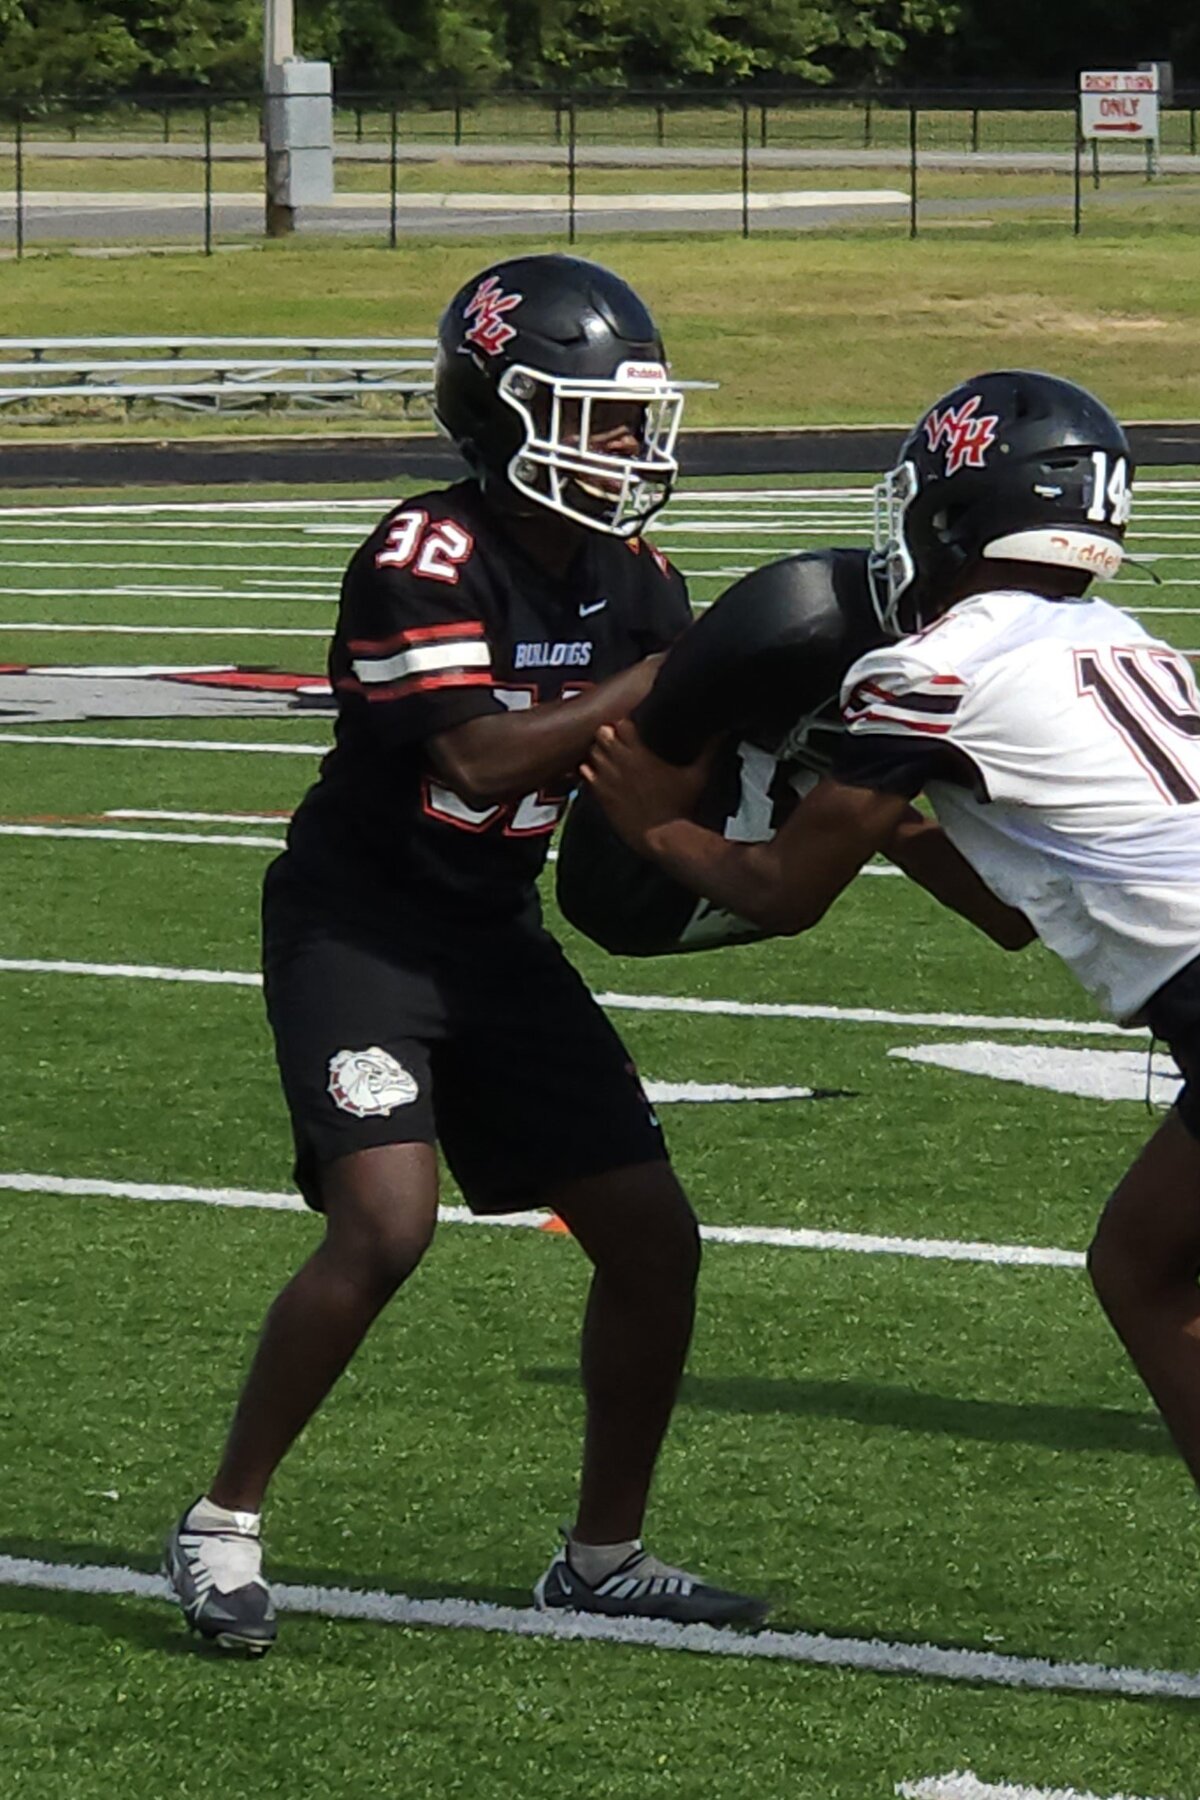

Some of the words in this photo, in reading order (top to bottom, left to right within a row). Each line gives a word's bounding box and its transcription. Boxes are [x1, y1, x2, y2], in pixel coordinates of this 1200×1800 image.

[1100, 98, 1140, 117] ONLY
[923, 394, 998, 477] WH
[1087, 450, 1132, 526] 14
[375, 508, 474, 586] 32
